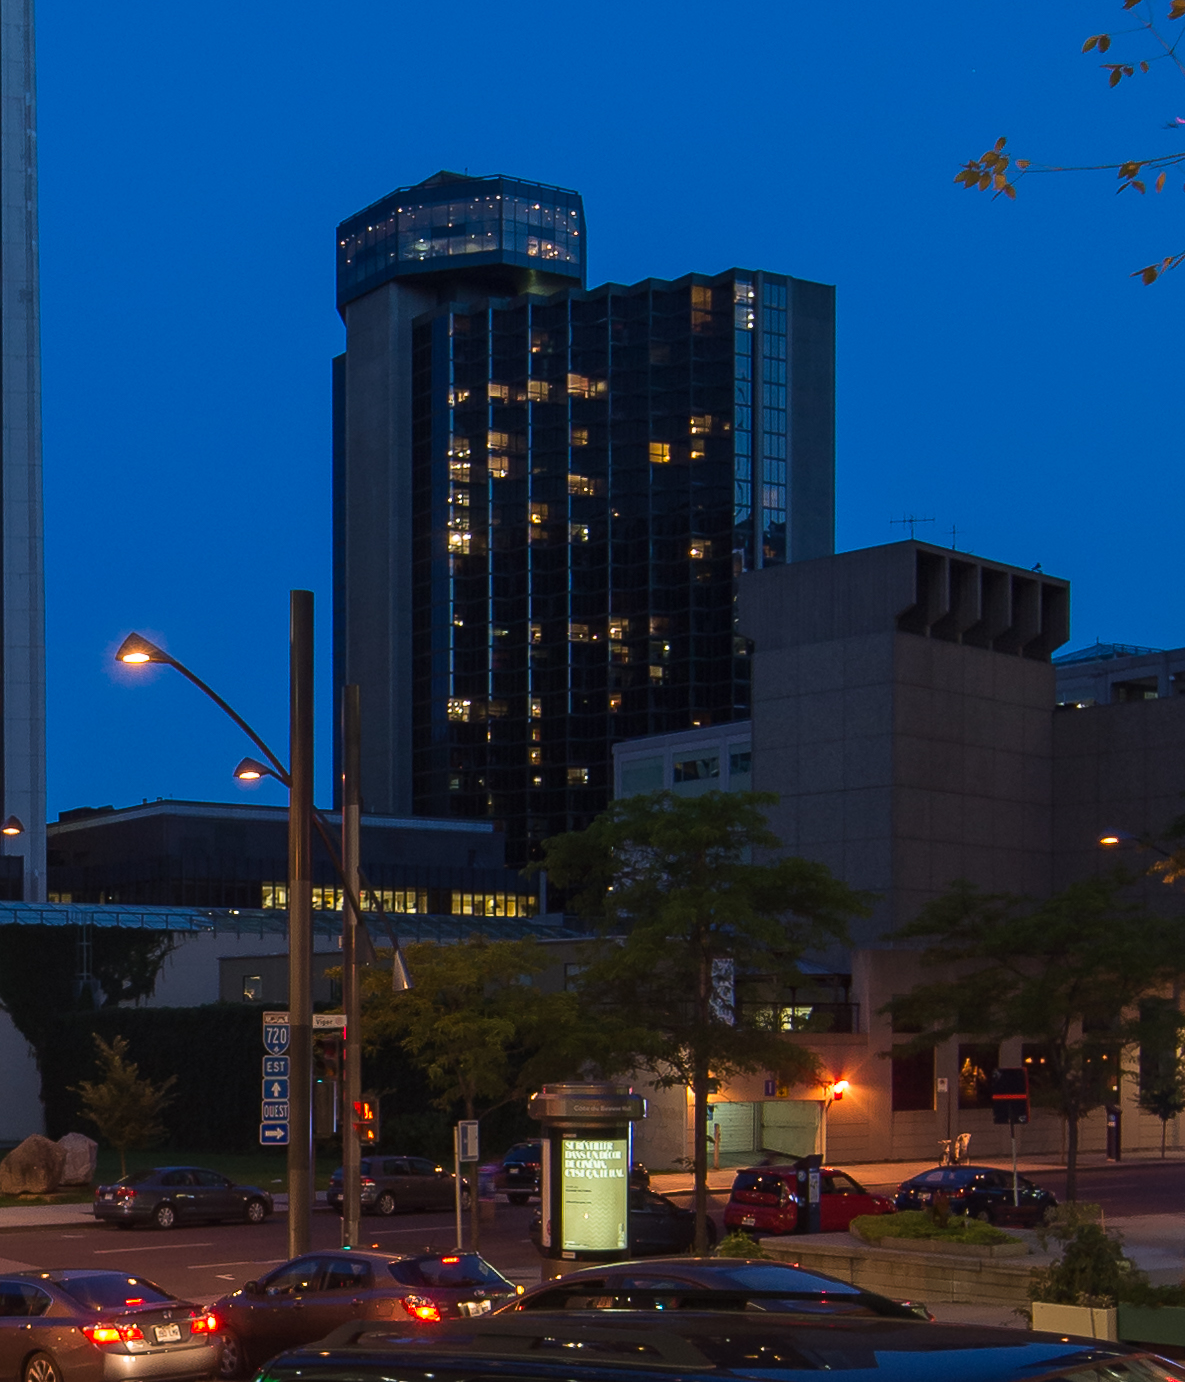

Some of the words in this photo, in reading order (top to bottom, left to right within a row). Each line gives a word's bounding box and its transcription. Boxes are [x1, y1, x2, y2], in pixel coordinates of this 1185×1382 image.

[266, 1027, 287, 1044] 720
[266, 1061, 285, 1072] EST
[264, 1105, 288, 1117] OUEST
[565, 1159, 575, 1168] DE
